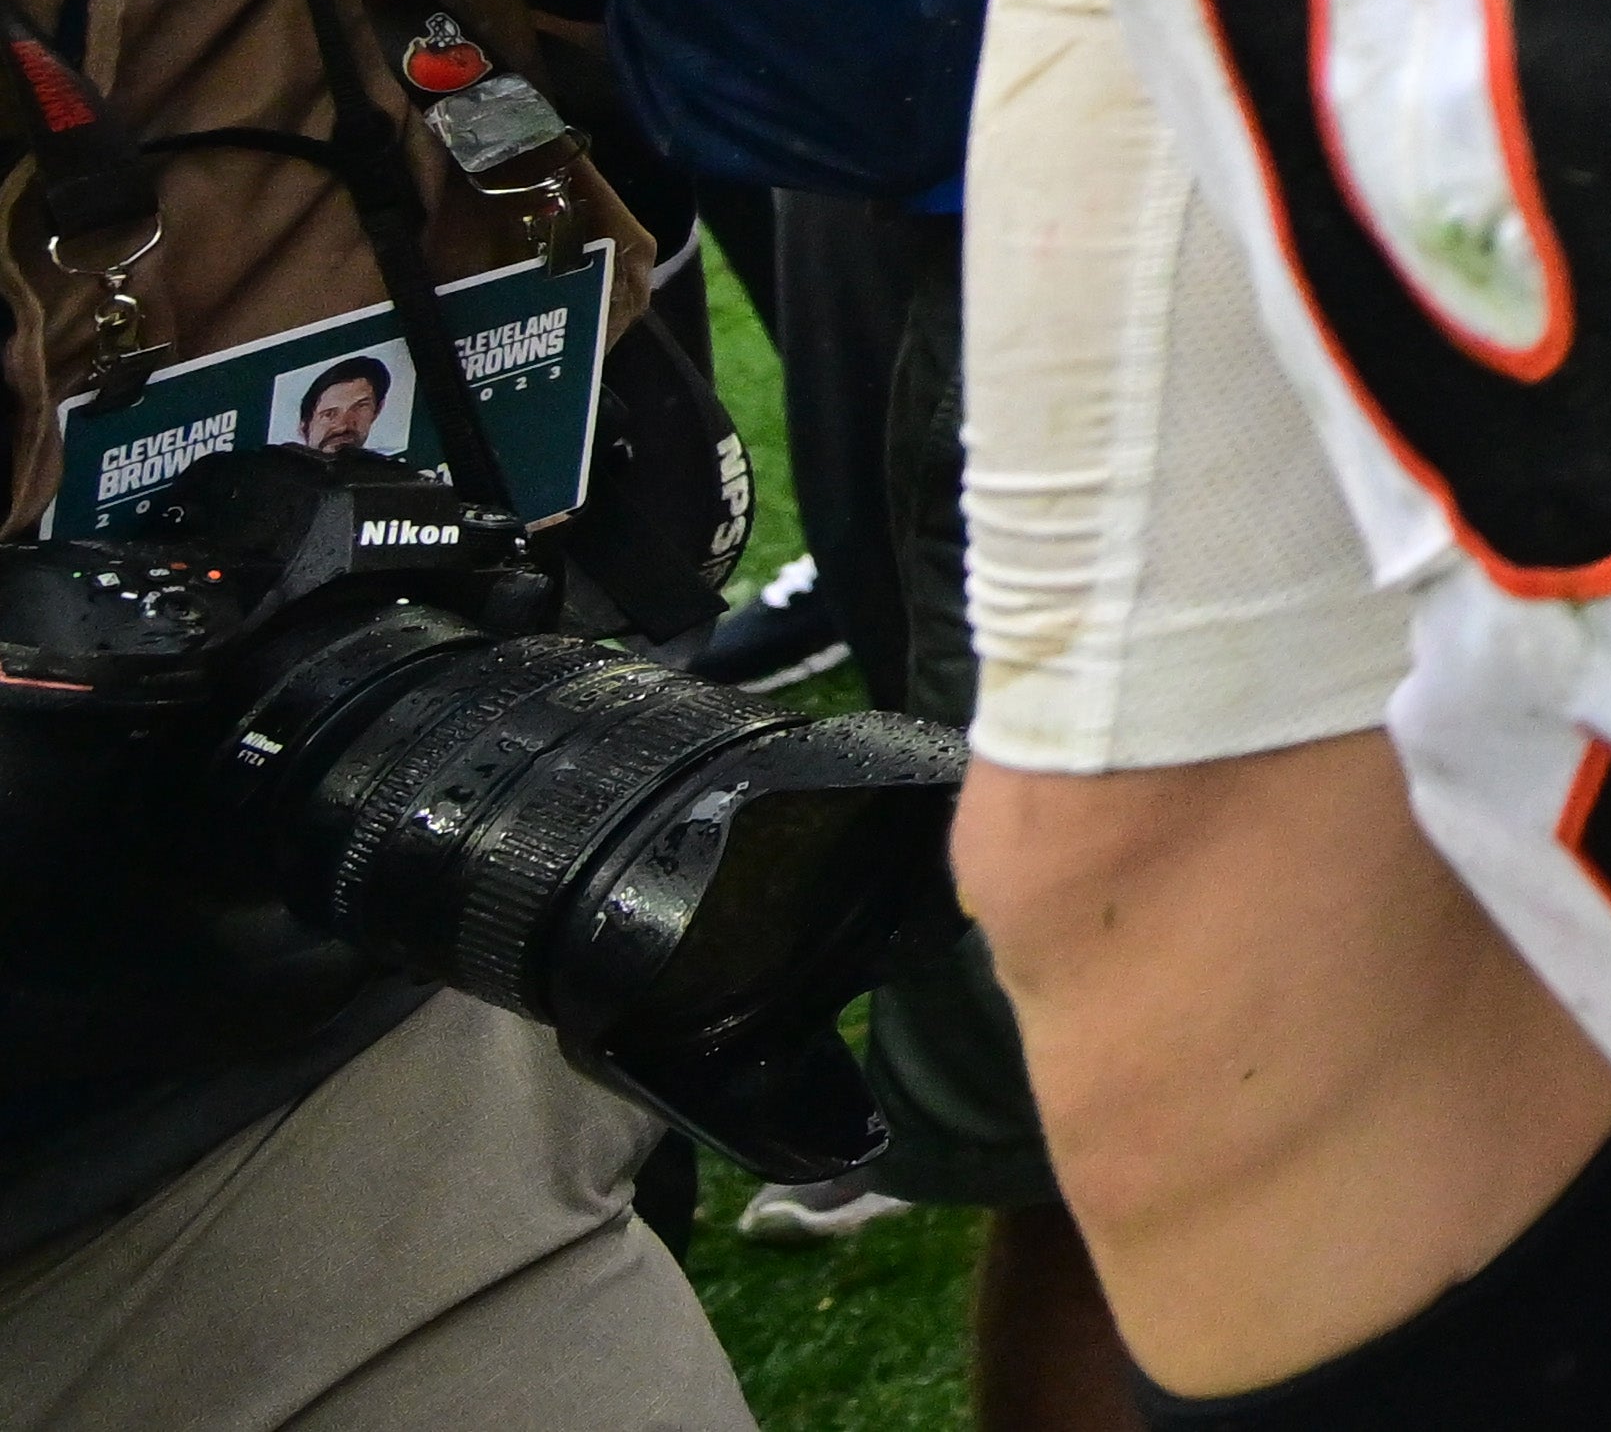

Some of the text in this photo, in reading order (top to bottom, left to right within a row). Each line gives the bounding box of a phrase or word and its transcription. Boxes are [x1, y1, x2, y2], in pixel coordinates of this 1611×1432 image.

[461, 327, 566, 381] ROWNS
[102, 409, 238, 473] CLEVELAND
[360, 519, 460, 546] Nikon
[241, 731, 283, 755] Nikon
